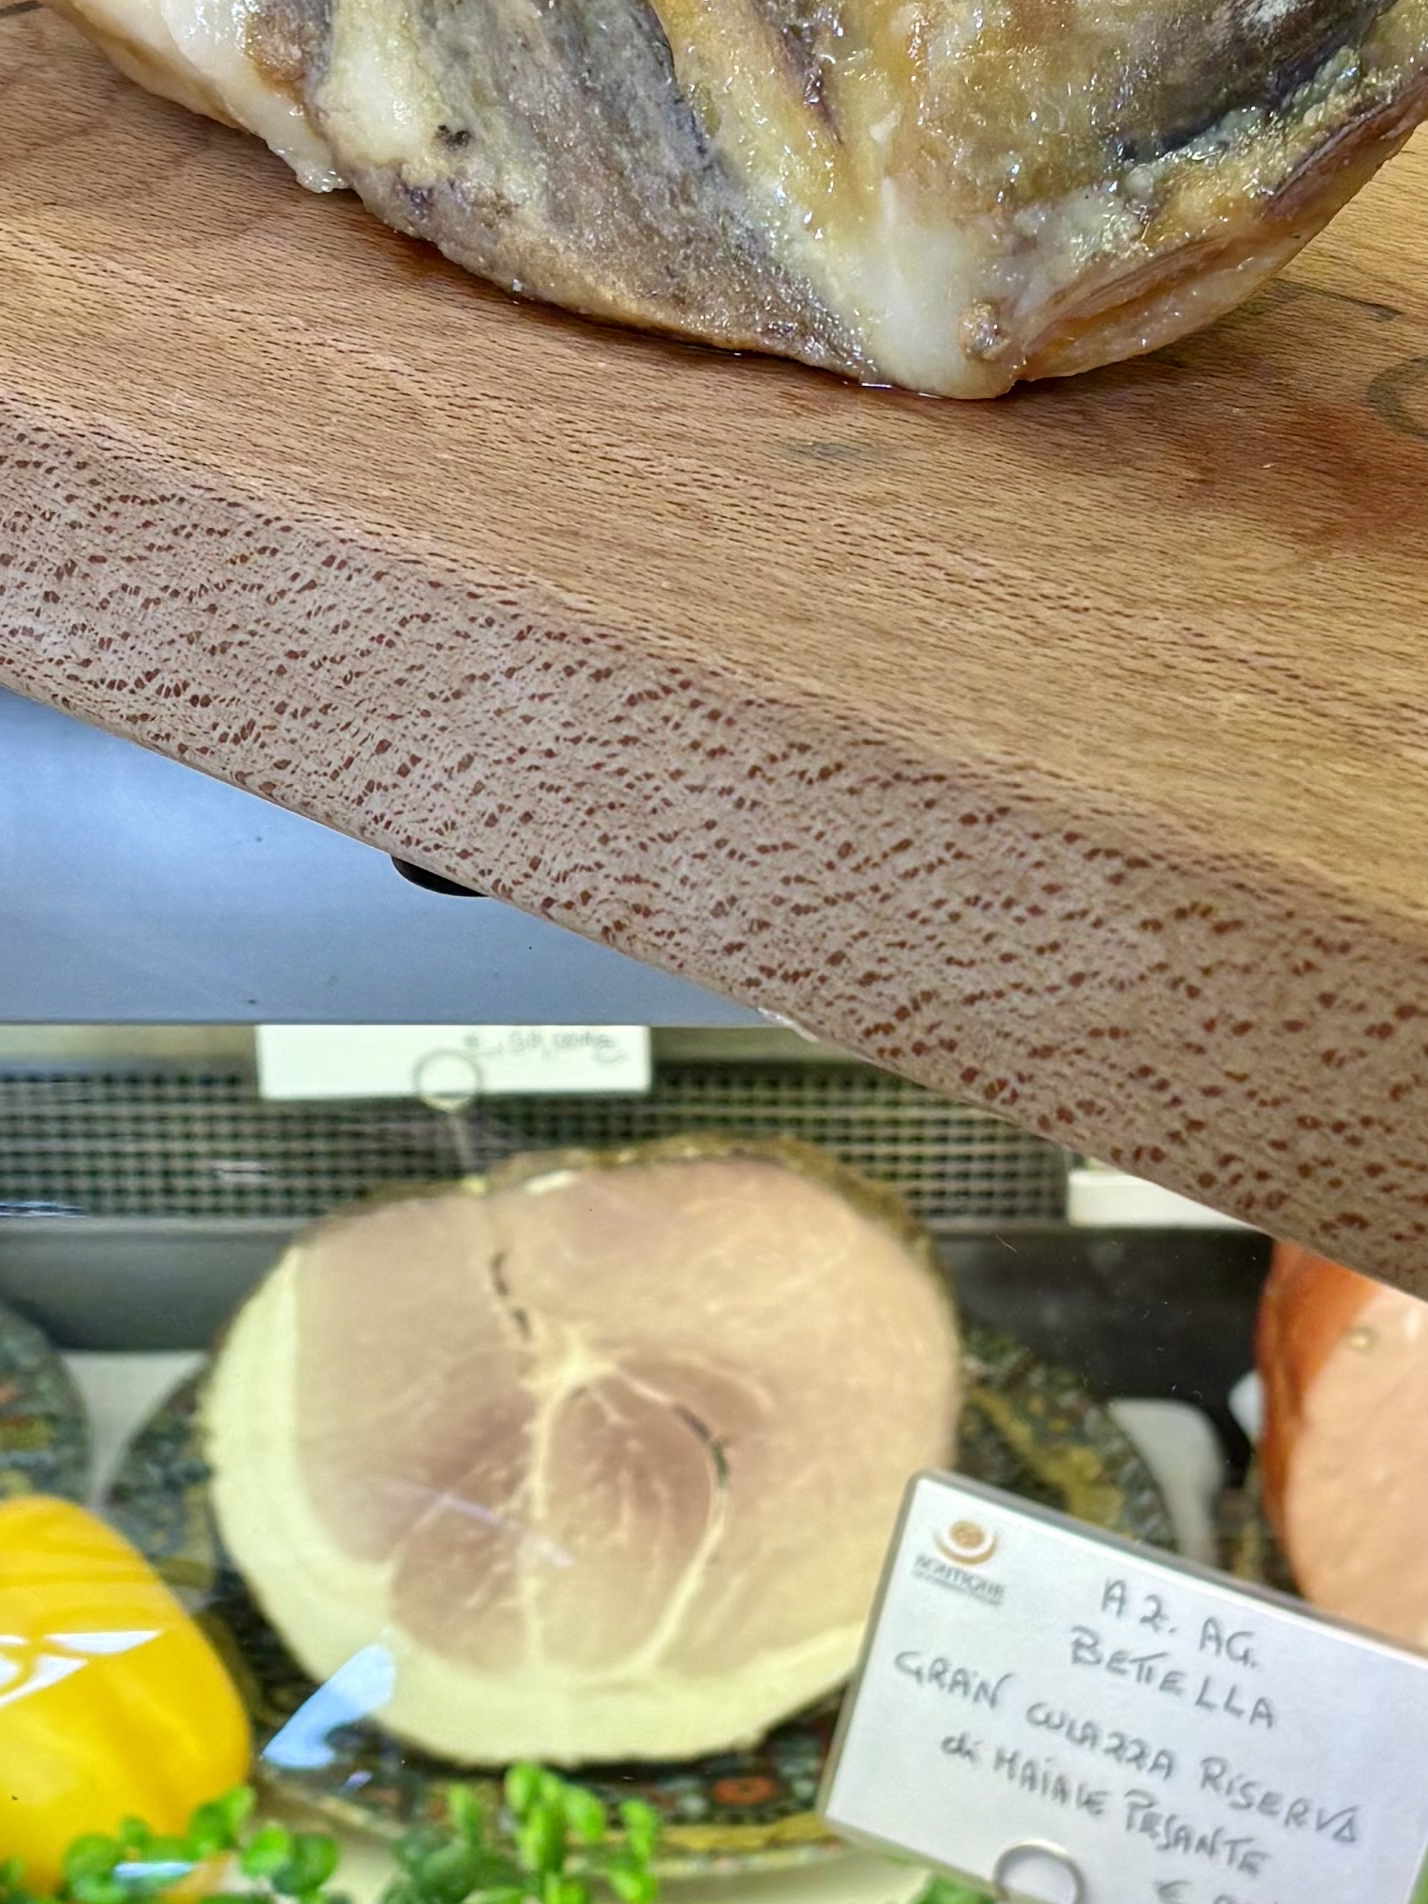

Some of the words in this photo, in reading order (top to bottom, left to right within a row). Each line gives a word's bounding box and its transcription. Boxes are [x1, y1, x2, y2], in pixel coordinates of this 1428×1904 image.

[894, 1650, 1015, 1710] GRAN
[1072, 1625, 1277, 1729] BETTELLA
[1124, 1788, 1271, 1878] PESANTE
